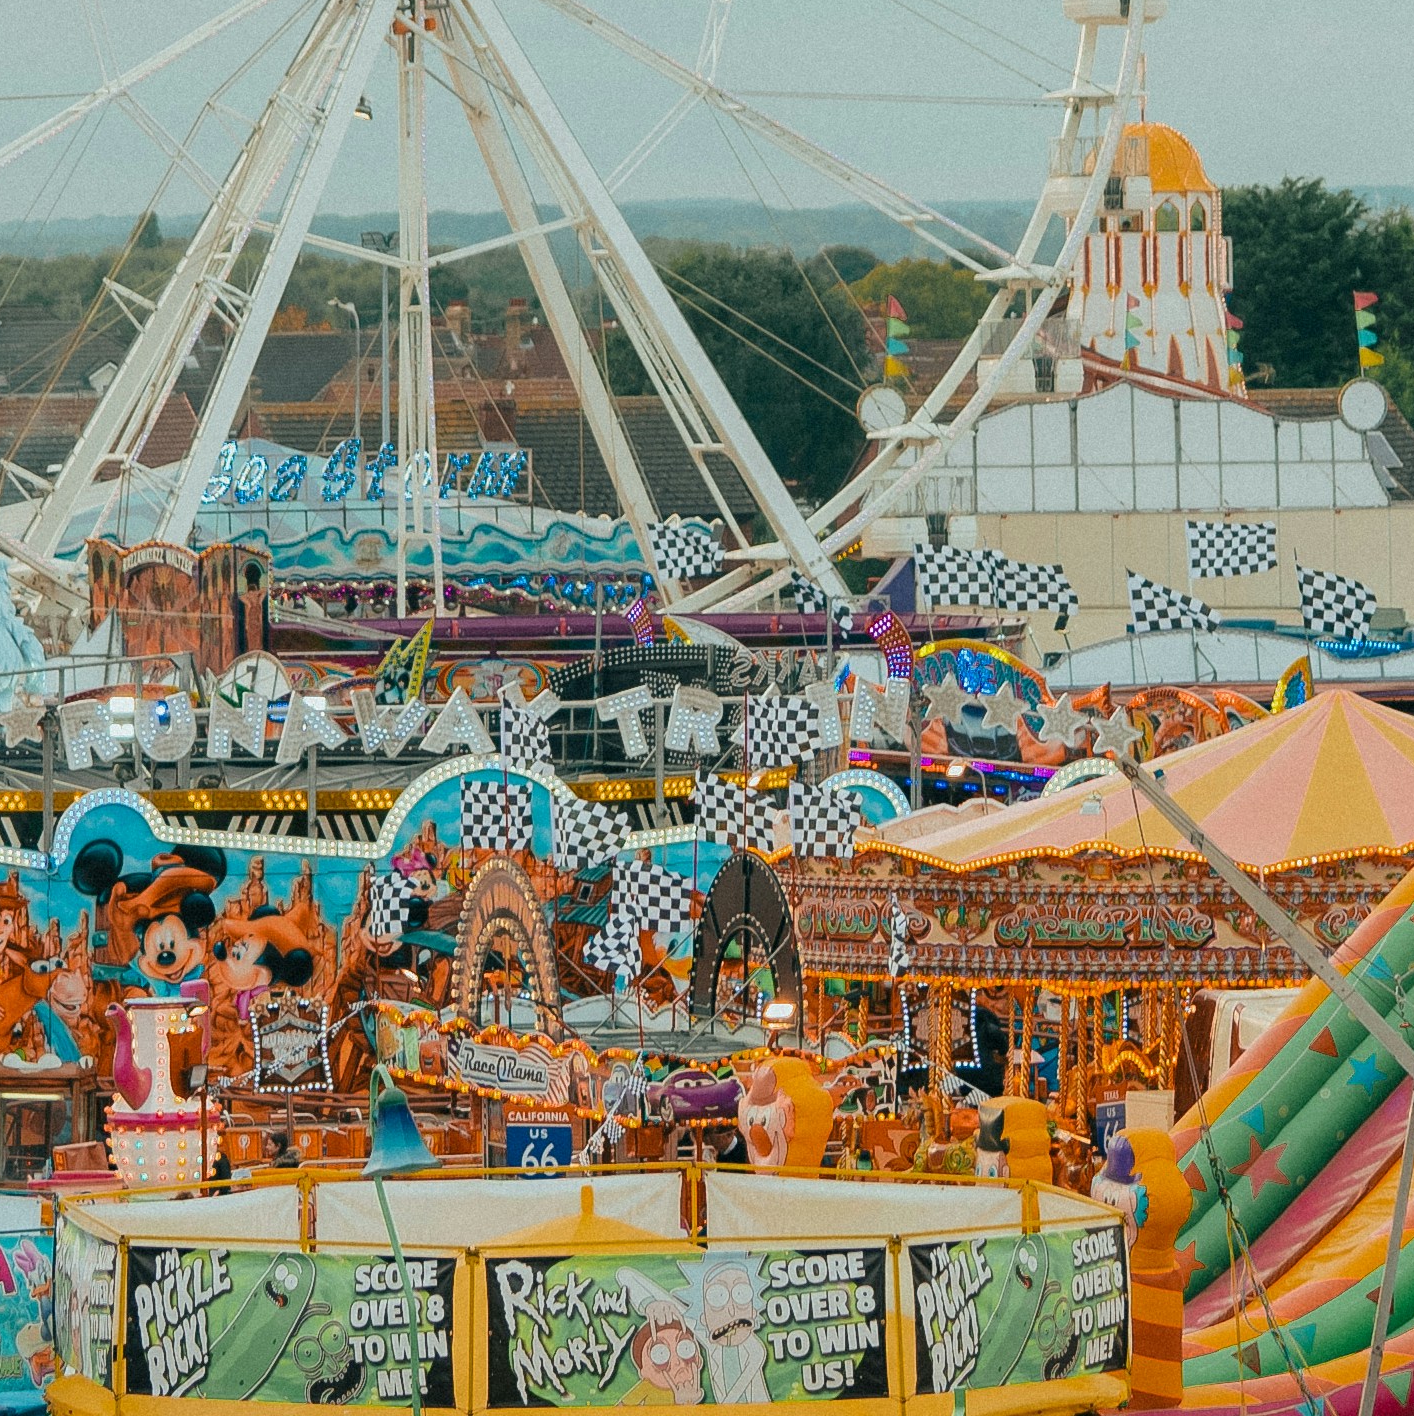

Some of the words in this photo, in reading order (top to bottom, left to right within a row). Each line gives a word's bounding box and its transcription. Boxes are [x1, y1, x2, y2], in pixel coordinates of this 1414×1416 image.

[594, 676, 913, 758] TRIN
[1103, 1090, 1119, 1101] TEXAS
[1106, 1106, 1117, 1118] US
[507, 1110, 570, 1123] CALIFORNIA
[529, 1127, 549, 1140] US
[520, 1141, 560, 1177] 66
[155, 1247, 182, 1282] I'M
[930, 1241, 950, 1277] I'M
[1071, 1227, 1118, 1268] SCORE
[354, 1260, 439, 1293] SCORE
[767, 1251, 866, 1290] SCORE
[1071, 1266, 1113, 1302] OVER
[1113, 1261, 1124, 1289] 8
[134, 1248, 232, 1350] PICKLE
[350, 1297, 420, 1328] OVER
[426, 1295, 445, 1323] 8
[766, 1290, 850, 1326] OVER
[854, 1285, 877, 1313] 8
[916, 1237, 993, 1350] PICKLE
[1071, 1305, 1095, 1336] TO
[1095, 1294, 1126, 1329] WIN
[146, 1308, 210, 1396] RICK!
[348, 1335, 387, 1364] TO
[390, 1329, 448, 1361] WIN
[767, 1330, 810, 1360] TO
[815, 1319, 880, 1355] WIN
[930, 1299, 980, 1394] RICK!
[1085, 1332, 1116, 1367] ME!
[801, 1360, 855, 1392] US!
